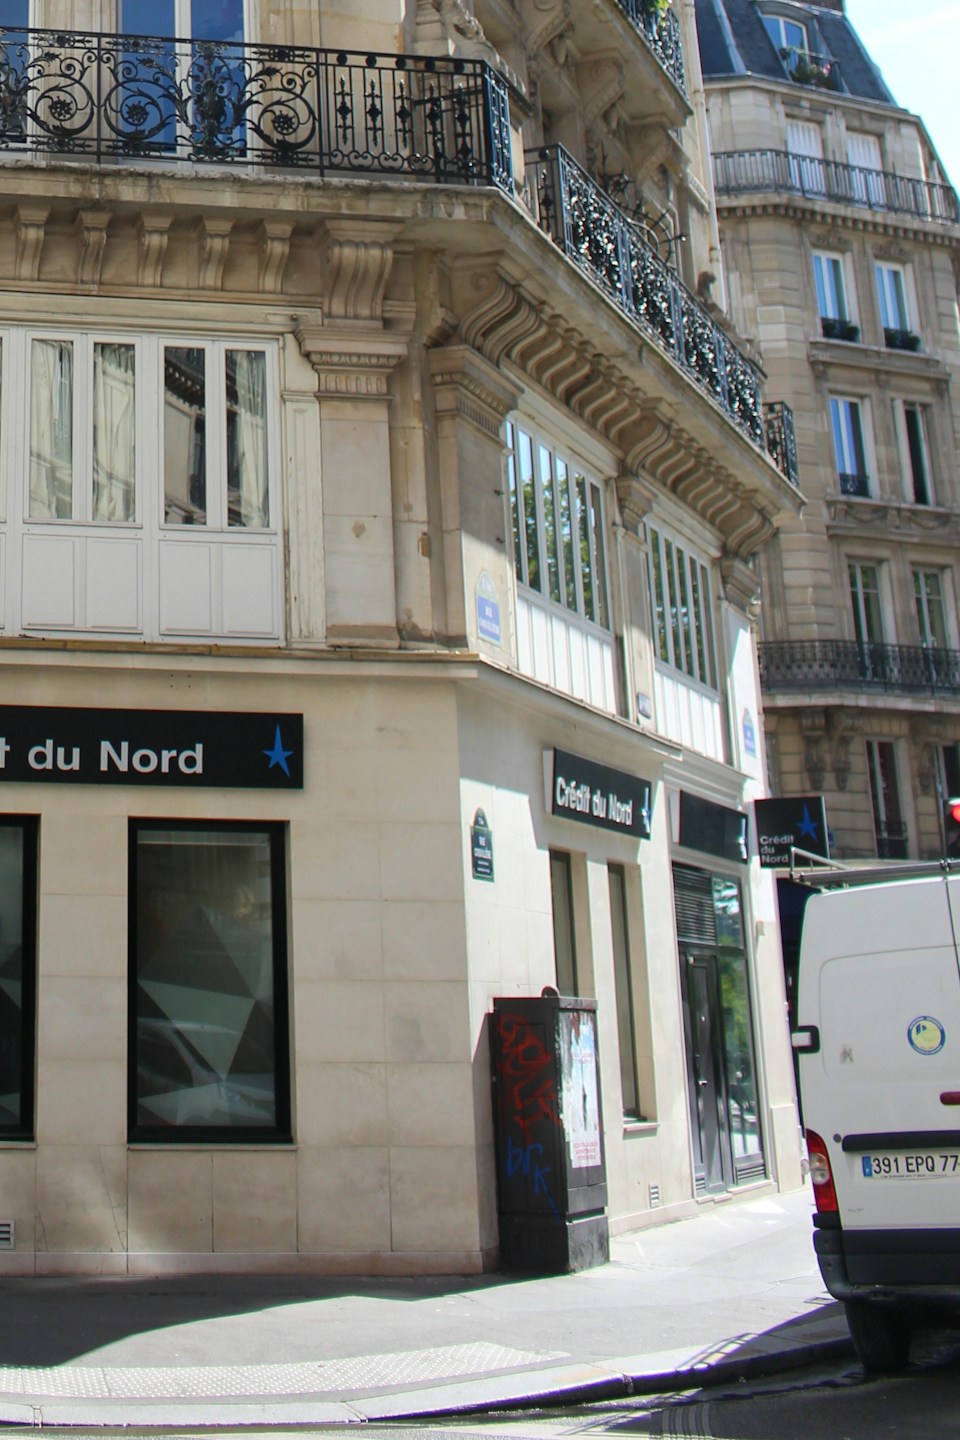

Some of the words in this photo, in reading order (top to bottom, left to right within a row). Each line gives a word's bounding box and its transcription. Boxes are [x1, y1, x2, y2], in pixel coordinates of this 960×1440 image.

[28, 739, 81, 771] du
[100, 740, 204, 775] Nord
[556, 776, 590, 814] Crédit
[592, 789, 606, 818] du
[608, 793, 633, 826] Nord
[760, 835, 794, 845] Crédit
[761, 845, 775, 855] du
[762, 855, 789, 864] Nord
[872, 1157, 899, 1174] 391
[905, 1155, 935, 1173] EPQ
[939, 1154, 958, 1171] 77
